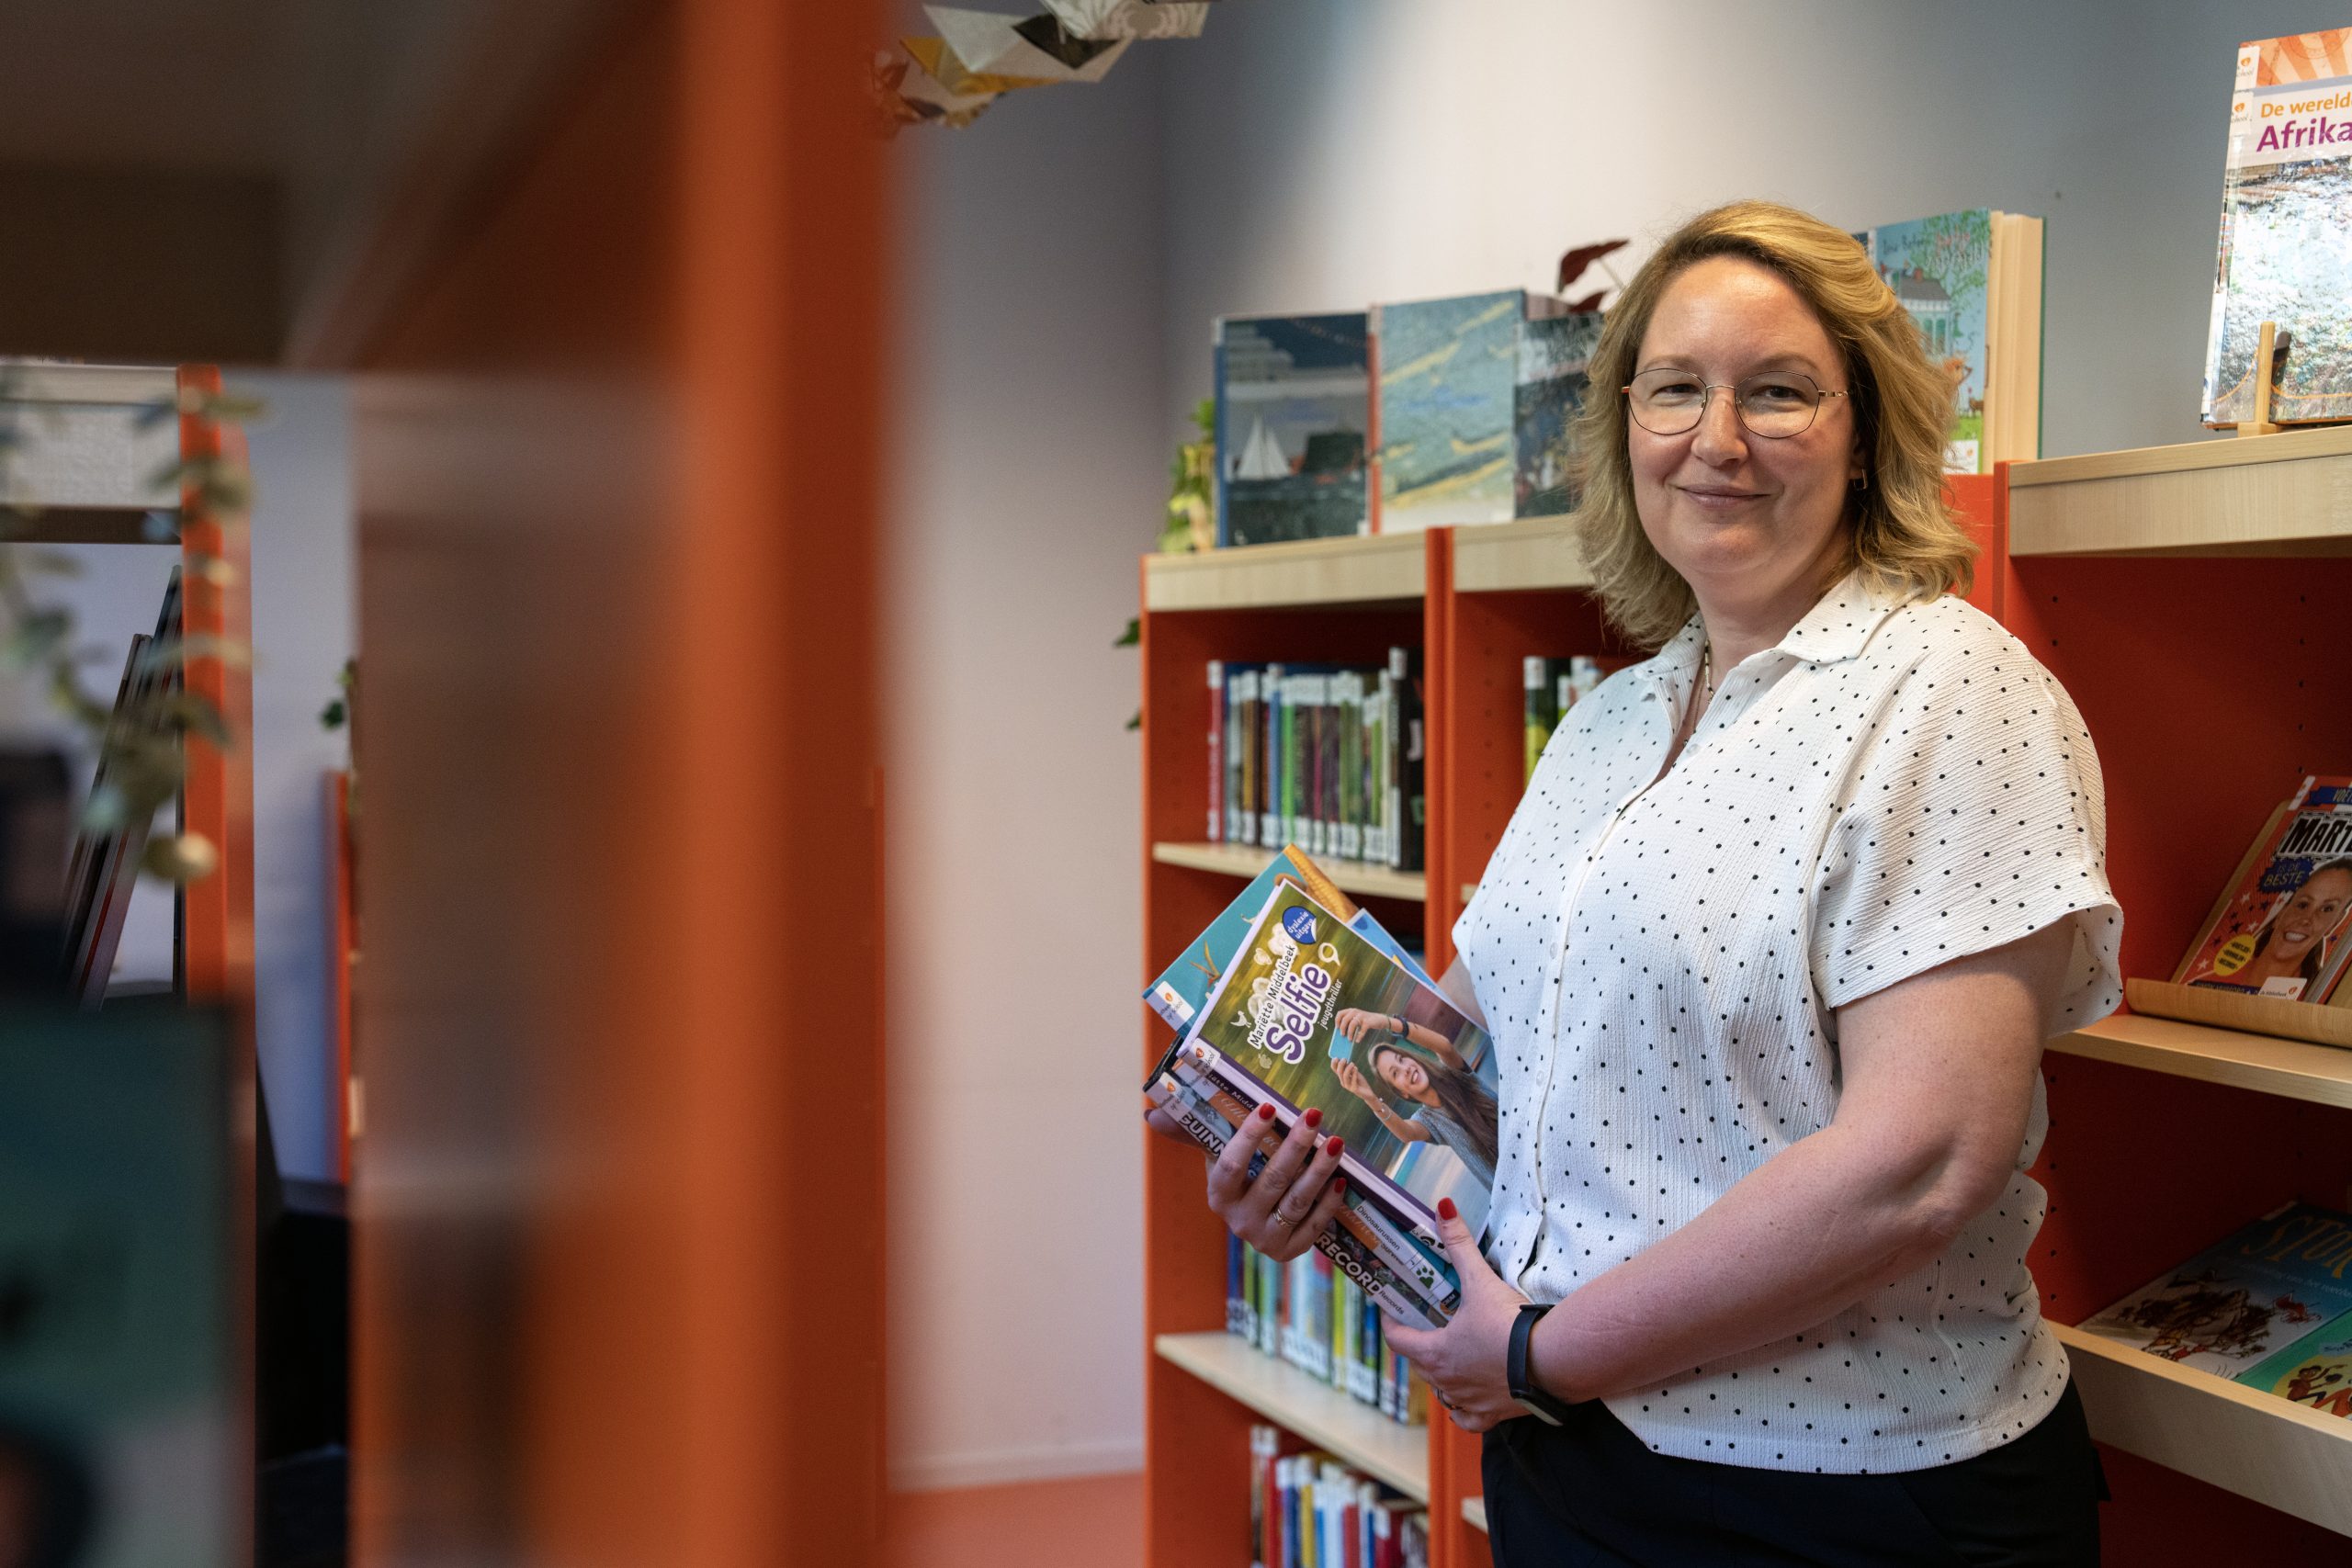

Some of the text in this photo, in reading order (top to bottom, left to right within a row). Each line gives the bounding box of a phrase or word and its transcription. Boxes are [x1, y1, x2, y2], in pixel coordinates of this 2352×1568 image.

[2260, 92, 2352, 118] De wereld
[2256, 117, 2352, 152] Afrika
[2279, 818, 2352, 854] MART
[2263, 870, 2305, 886] BESTE
[1287, 911, 1309, 934] dyslexie
[1295, 918, 1315, 940] uitgave
[1250, 944, 1295, 1047] Mariëtte Middelbeek
[1318, 978, 1342, 1031] jeugdthriller
[1265, 966, 1328, 1061] Selfie
[1231, 1090, 1255, 1111] Midde
[1356, 1205, 1401, 1251] Dinosaurussen
[1379, 1290, 1405, 1315] Records
